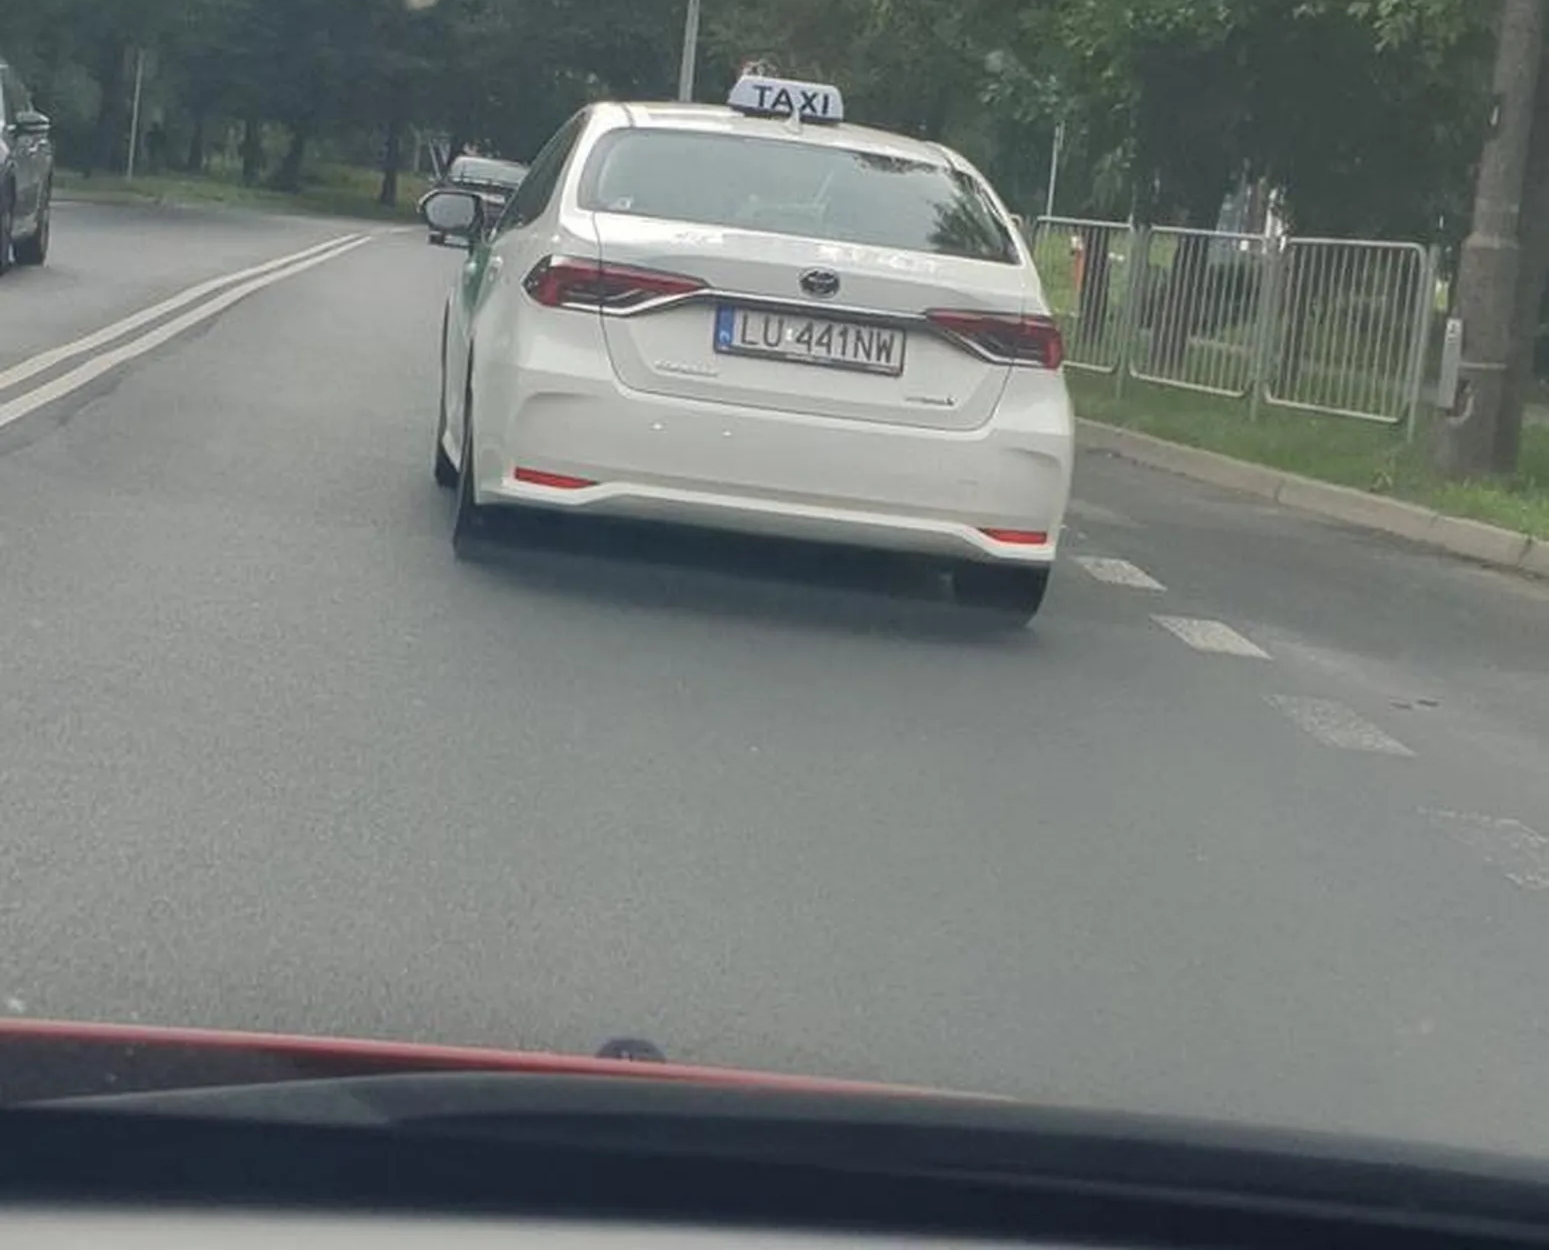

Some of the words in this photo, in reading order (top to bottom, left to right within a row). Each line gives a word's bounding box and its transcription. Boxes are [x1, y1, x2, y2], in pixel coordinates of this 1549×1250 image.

[752, 84, 829, 115] TAXI
[740, 312, 784, 348] LU
[796, 321, 895, 364] 441NW
